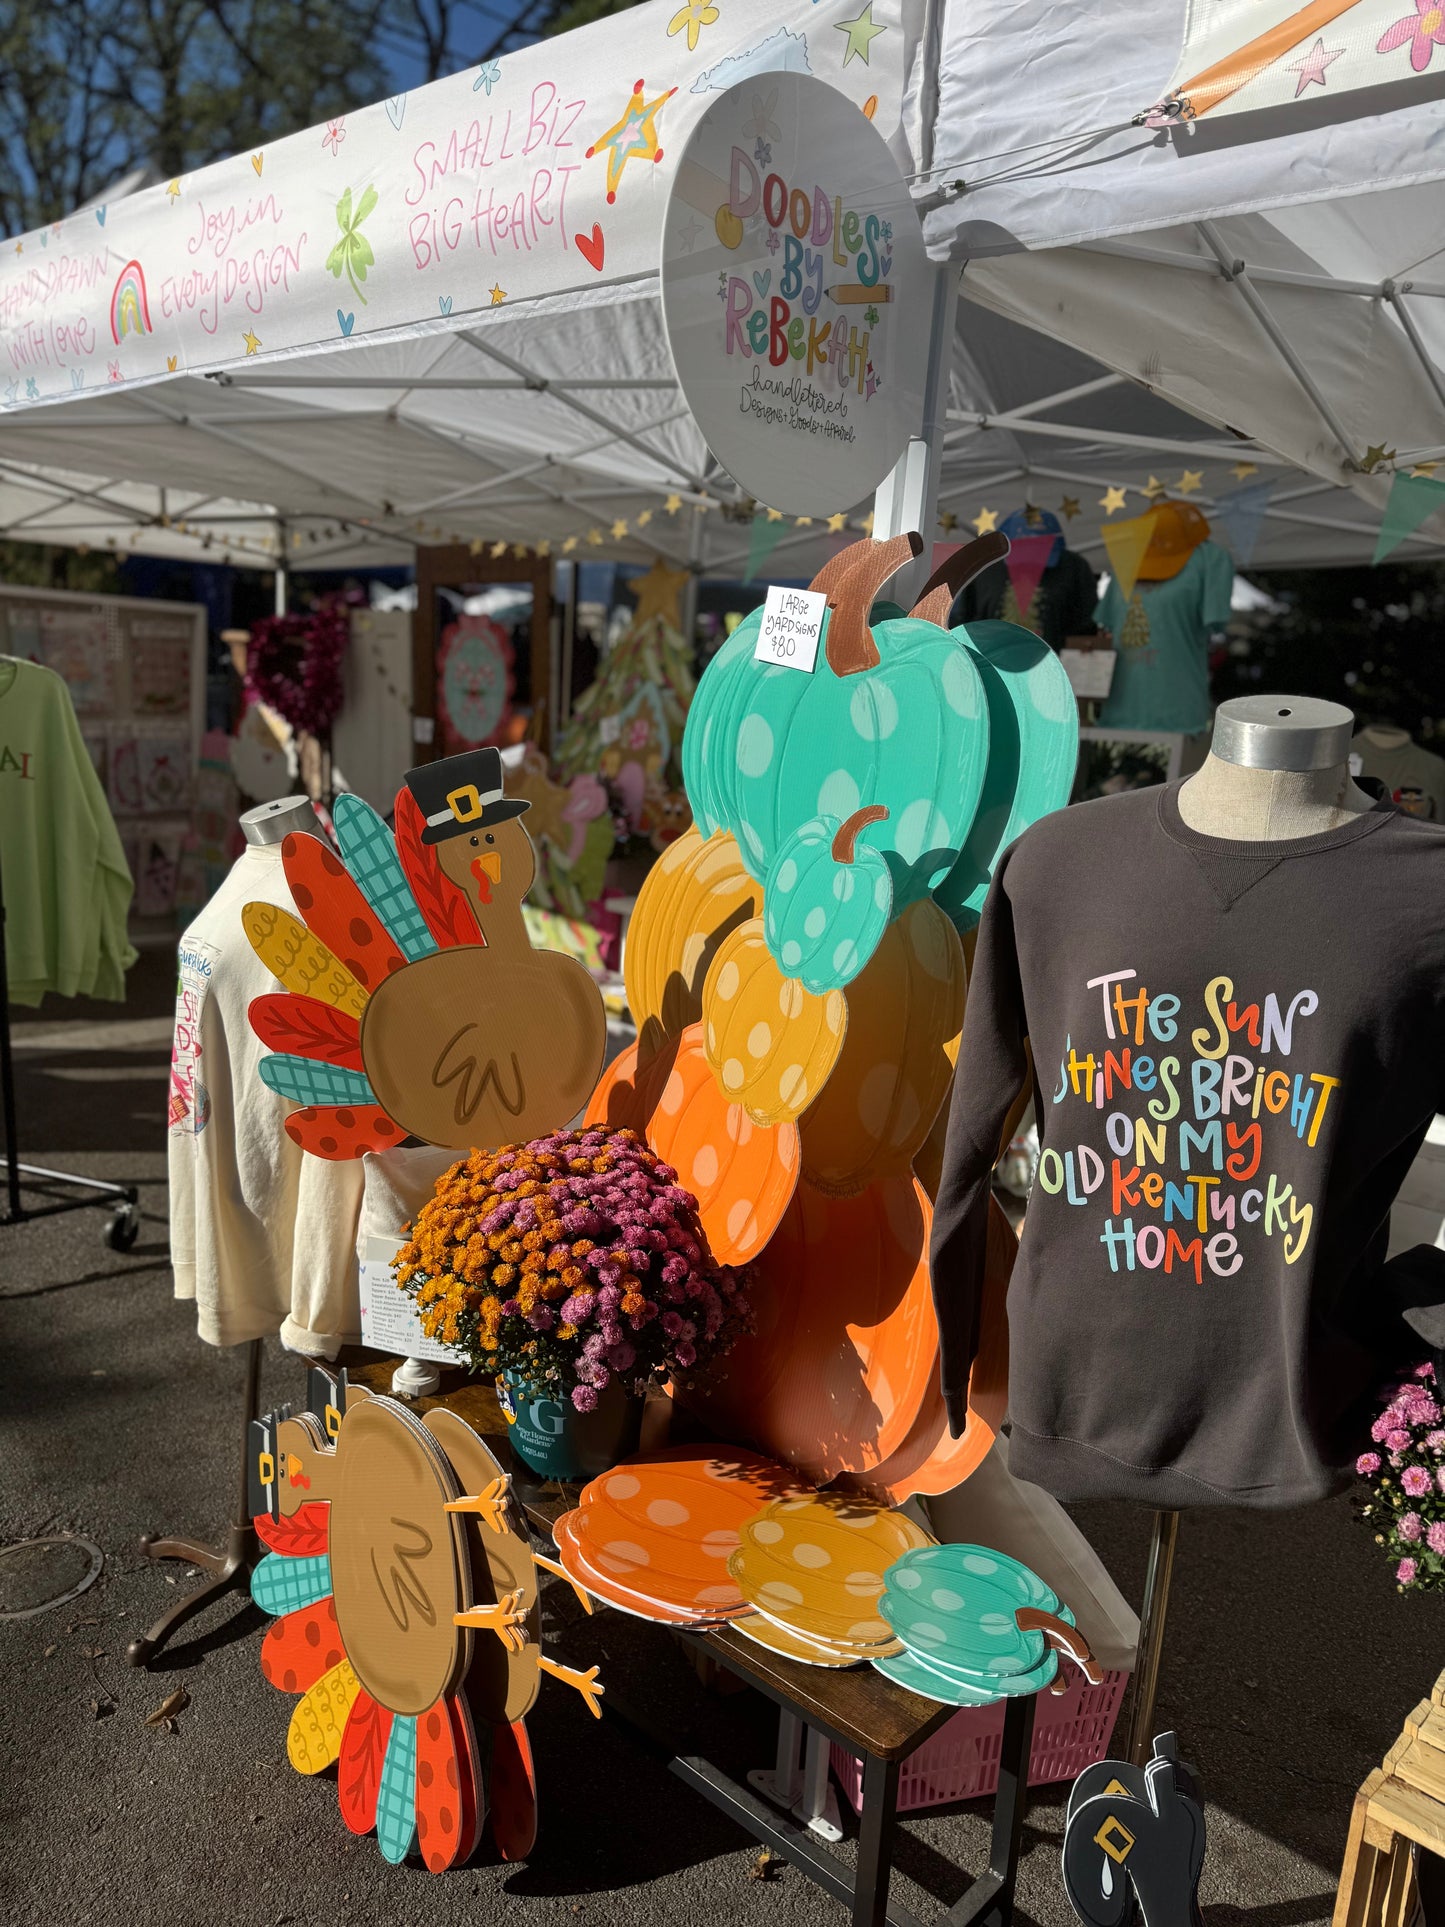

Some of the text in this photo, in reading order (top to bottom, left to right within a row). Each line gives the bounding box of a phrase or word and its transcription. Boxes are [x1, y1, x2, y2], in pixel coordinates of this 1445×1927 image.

[404, 109, 514, 206] SMALL
[188, 193, 283, 258] Joy in
[771, 635, 796, 658] $80
[1105, 1111, 1167, 1167] ON
[1039, 1144, 1106, 1206] OLD
[529, 1399, 568, 1435] G
